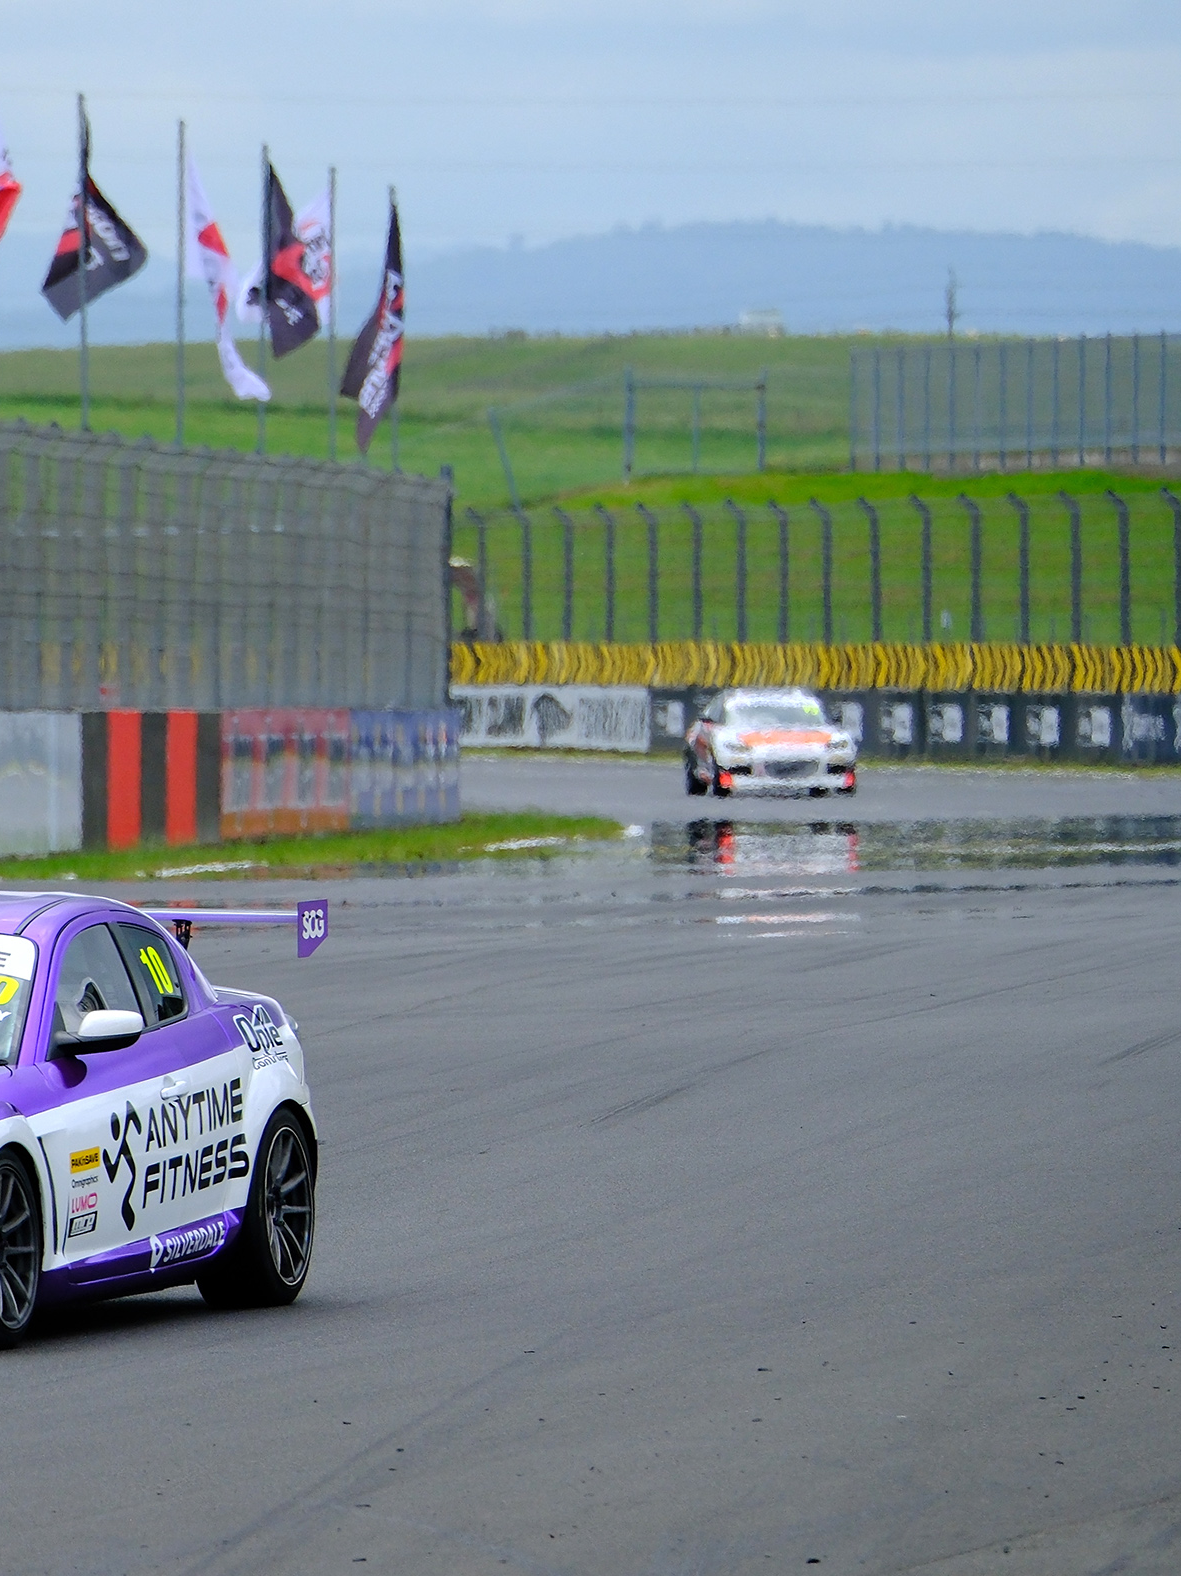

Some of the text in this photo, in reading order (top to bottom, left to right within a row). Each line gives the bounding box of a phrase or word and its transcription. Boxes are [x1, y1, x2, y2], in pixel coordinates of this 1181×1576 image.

[139, 946, 174, 994] 10
[146, 1077, 243, 1152] ANYTIME
[142, 1133, 249, 1209] FITNESS
[71, 1192, 98, 1214] LUMO
[163, 1221, 225, 1263] SILVERDALE
